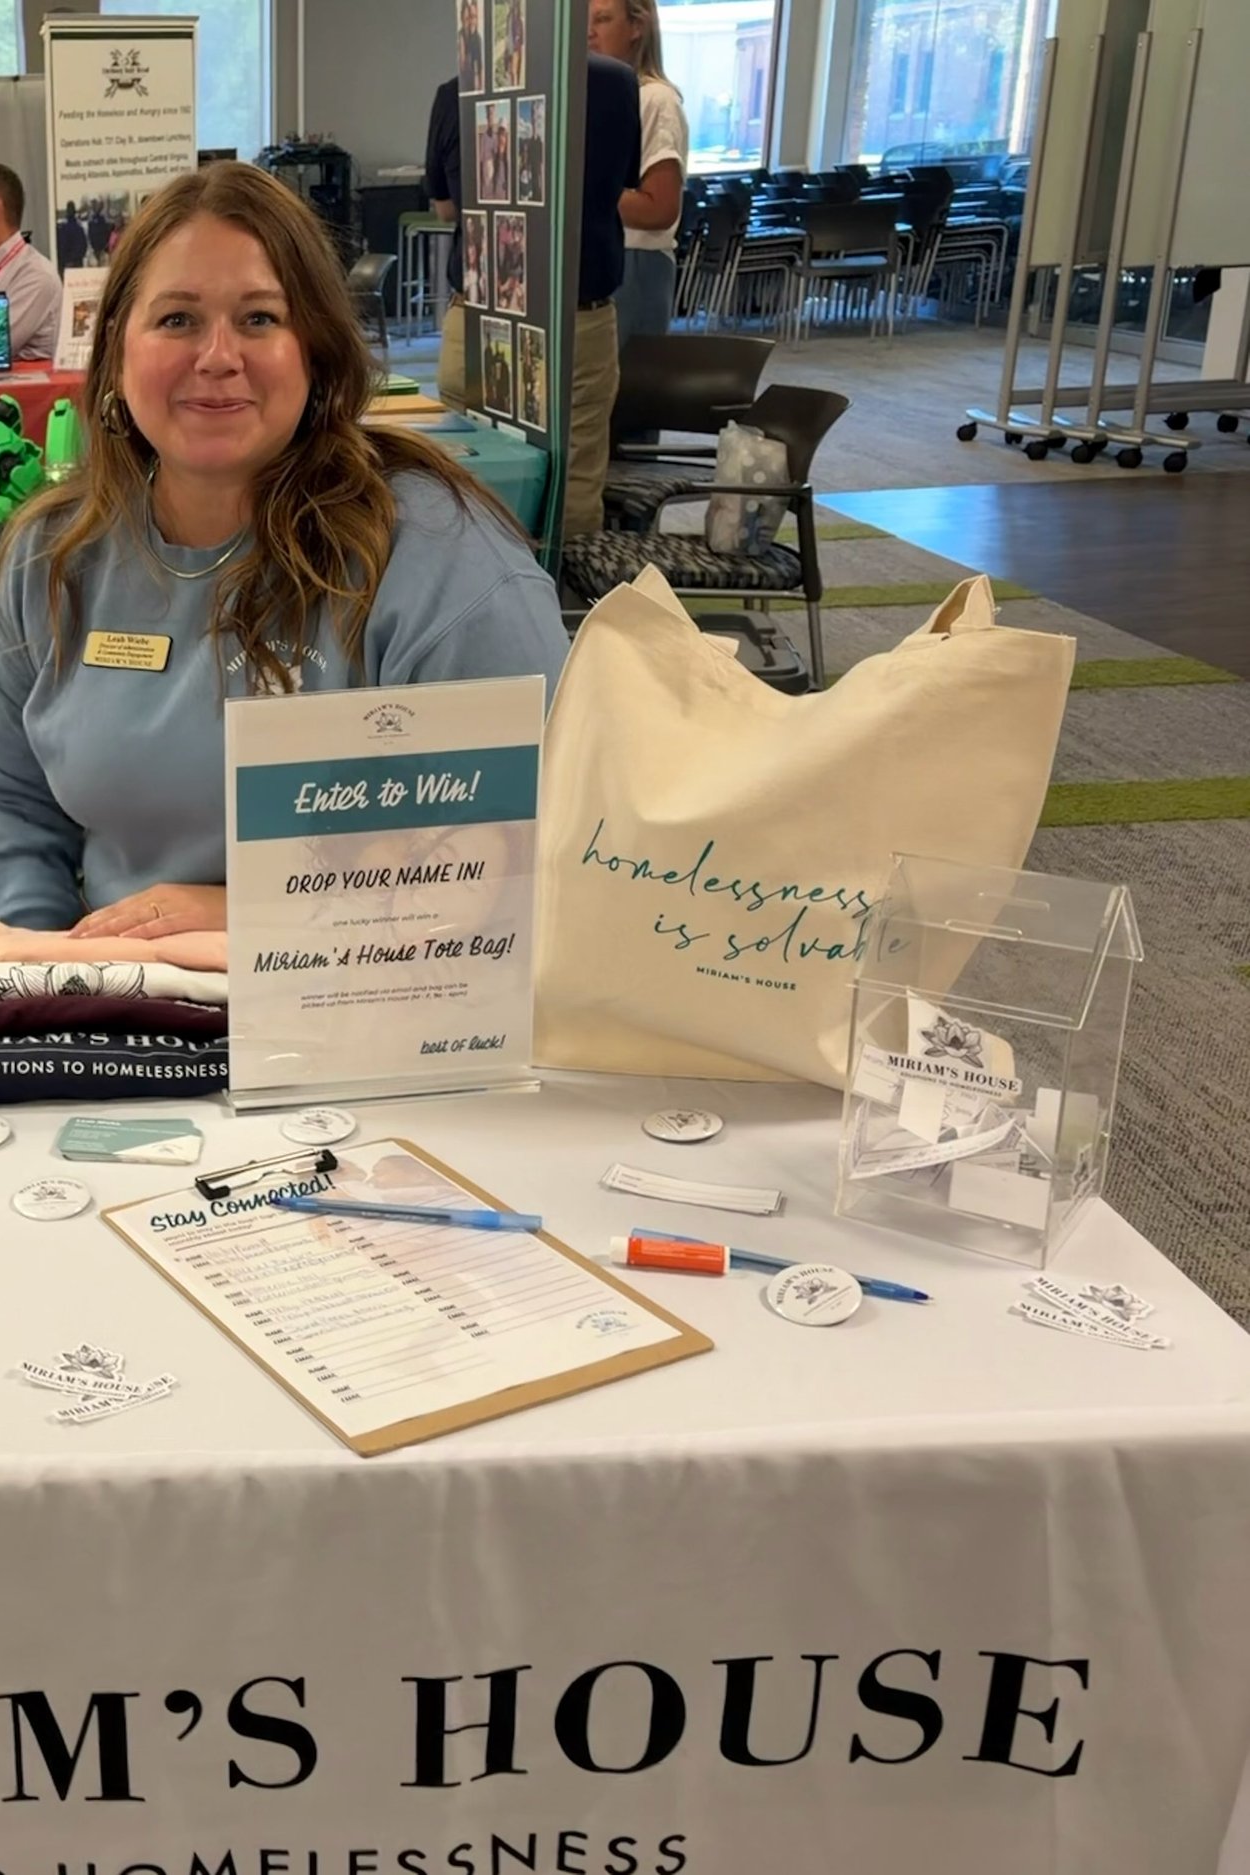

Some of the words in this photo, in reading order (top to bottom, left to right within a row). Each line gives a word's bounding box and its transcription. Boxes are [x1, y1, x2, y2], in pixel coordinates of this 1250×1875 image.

[294, 780, 369, 814] Enter
[377, 778, 409, 807] to
[415, 770, 481, 805] Win!
[286, 872, 337, 894] DROP
[343, 868, 391, 889] YOUR
[396, 863, 453, 886] NAME
[456, 861, 485, 881] IN!
[582, 818, 876, 920] homelessness
[356, 944, 417, 965] House
[424, 939, 464, 960] Tote
[469, 933, 515, 960] Bag!
[654, 914, 710, 949] is
[696, 966, 751, 985] MIRIAM'S
[756, 978, 797, 991] HOUSE
[420, 1039, 448, 1055] best
[468, 1034, 506, 1051] luck!
[62, 1062, 84, 1075] TO
[92, 1062, 229, 1079] HOMELESSNESS
[887, 1055, 959, 1079] MIRIAM'S
[964, 1071, 1019, 1092] HOUSE
[151, 1210, 207, 1232] Stay
[211, 1173, 337, 1217] Connected!
[398, 1649, 1090, 1789] HOUSE
